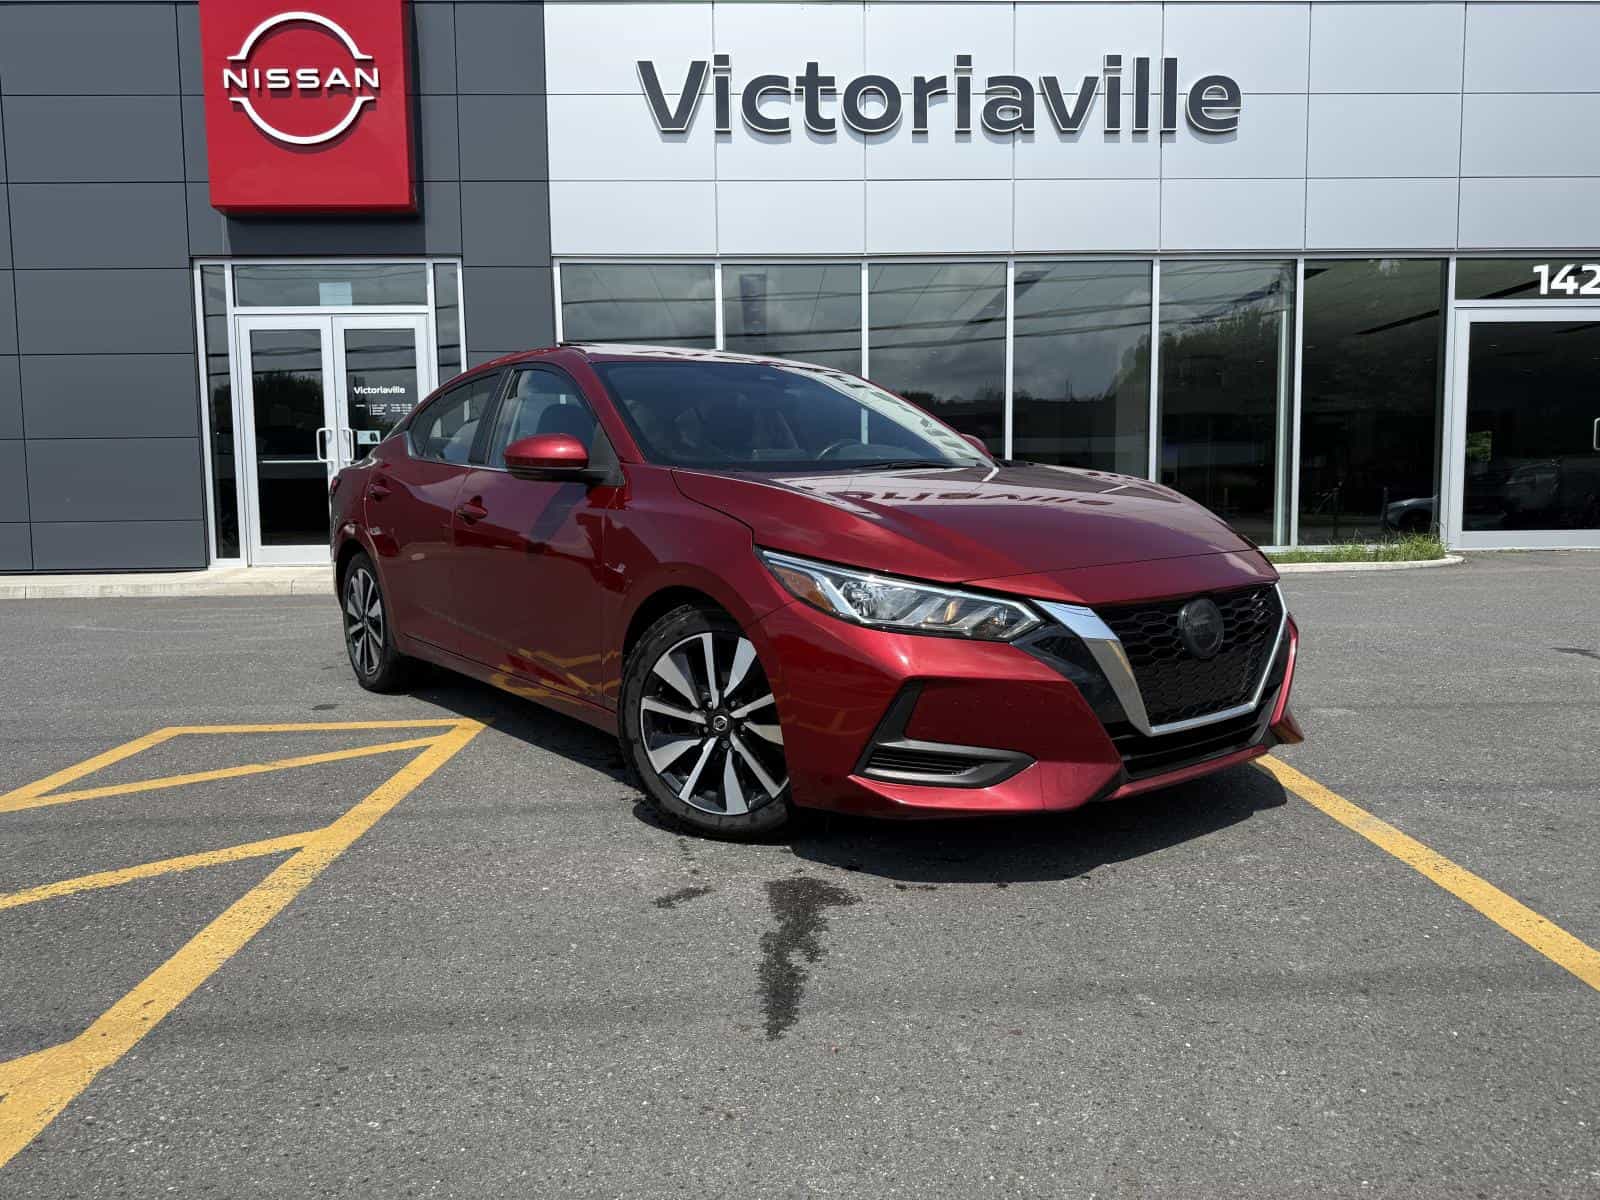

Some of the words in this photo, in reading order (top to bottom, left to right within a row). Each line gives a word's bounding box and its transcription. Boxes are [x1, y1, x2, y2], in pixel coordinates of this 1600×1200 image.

[223, 67, 380, 89] NISSAN
[635, 54, 1242, 134] Victoriaville
[1532, 263, 1600, 295] 142
[353, 385, 406, 394] Victoriaville
